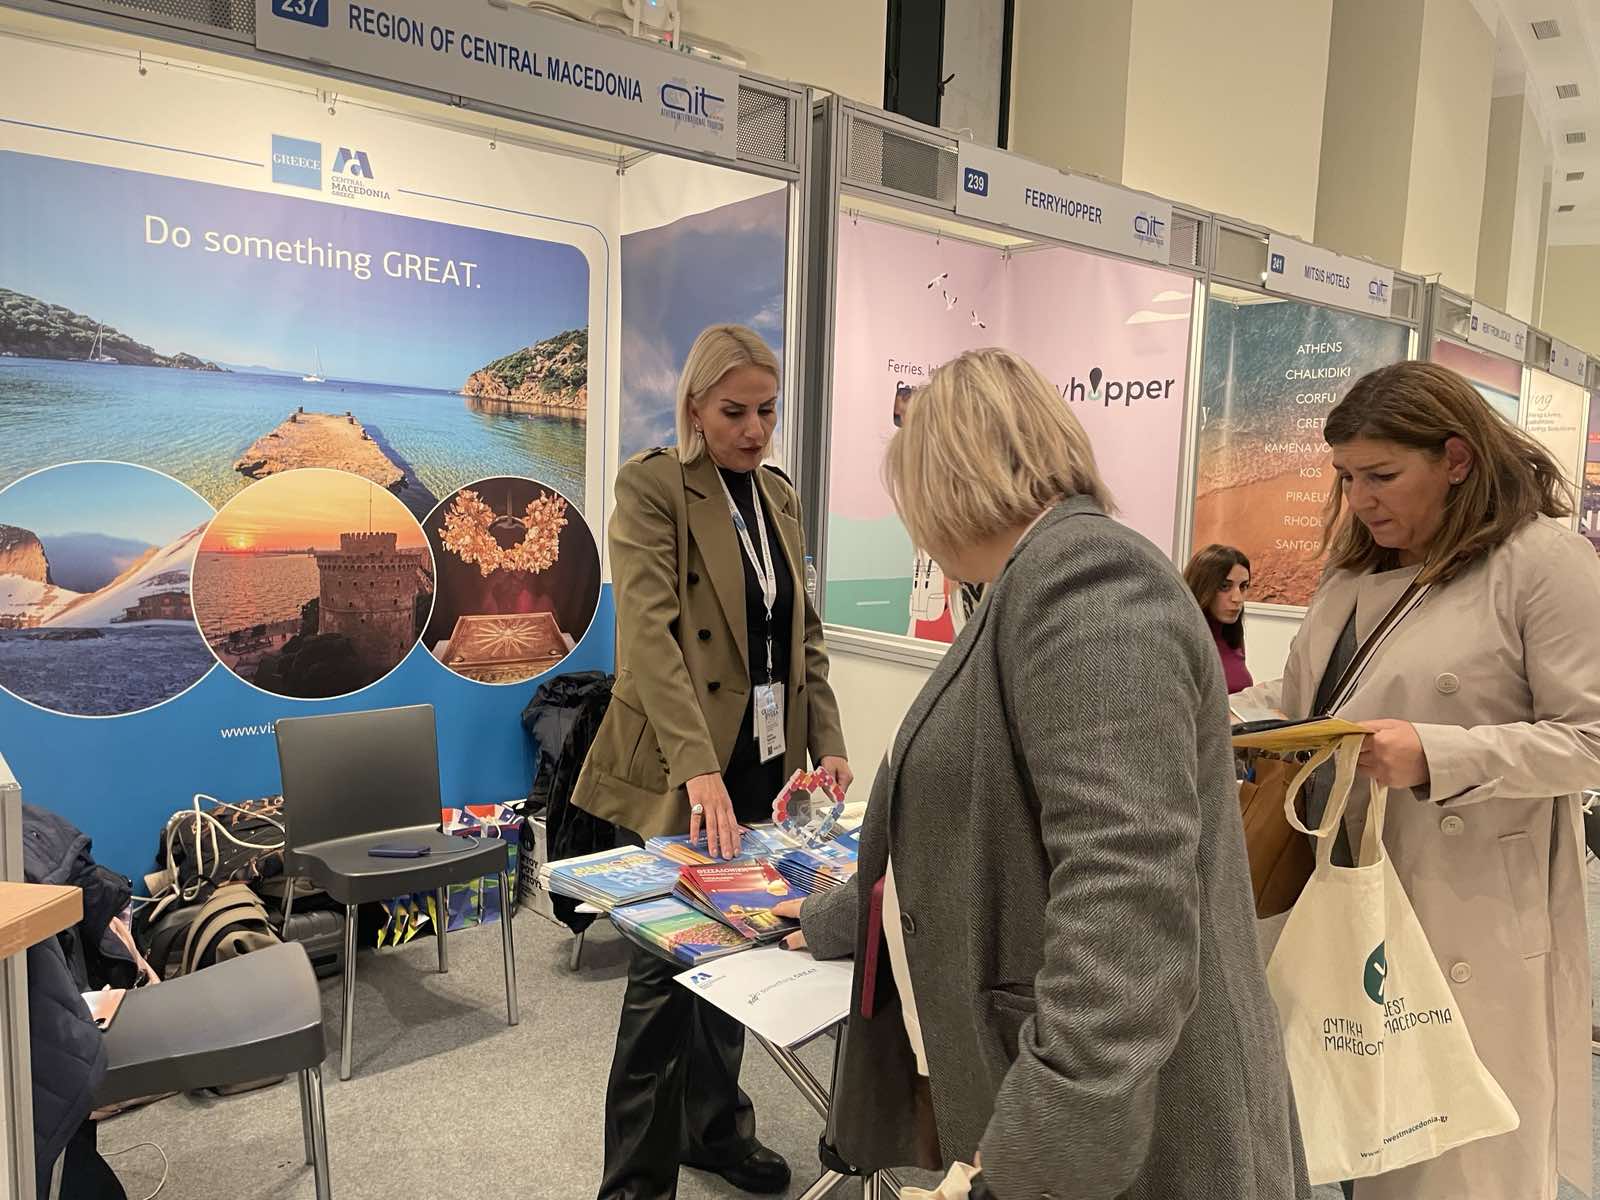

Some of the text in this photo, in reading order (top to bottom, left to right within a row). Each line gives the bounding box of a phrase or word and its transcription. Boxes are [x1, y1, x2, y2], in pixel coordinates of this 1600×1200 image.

[349, 4, 643, 103] REGION OF CENTRAL MACEDONIA
[272, 153, 321, 170] GREECE
[331, 176, 364, 187] CENTRAL
[967, 173, 984, 191] 239
[331, 182, 391, 200] MACEDONIA
[1025, 188, 1102, 224] FERRYHOPPER
[144, 214, 481, 289] Do something GREAT.
[1304, 265, 1350, 289] MITSIS HOTELS
[1296, 341, 1343, 355] ATHENS
[888, 359, 925, 376] Ferries.
[1285, 367, 1351, 380] CHALKIDIKI
[1295, 393, 1337, 405] CORFU
[1296, 418, 1326, 429] CRET
[1264, 442, 1331, 454] KAMENA VO
[1299, 467, 1322, 478] KOS
[1274, 538, 1321, 551] SANTOR
